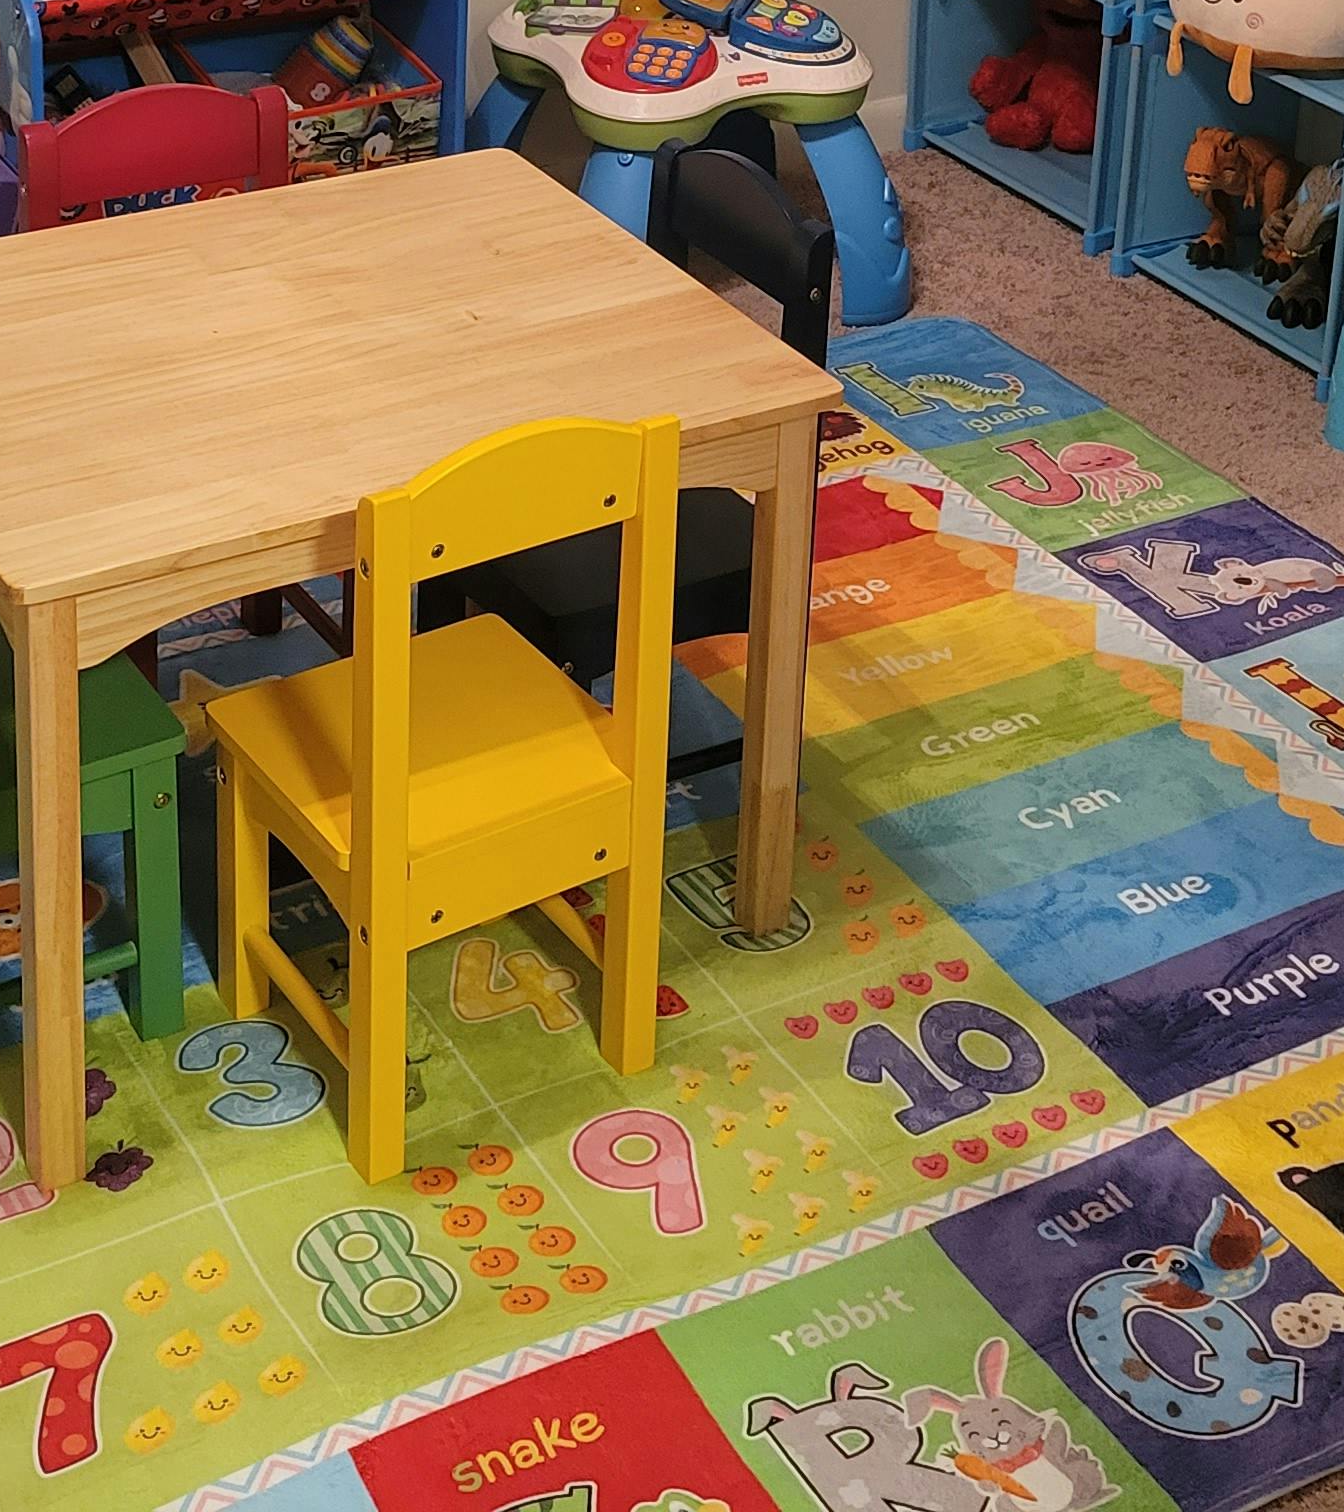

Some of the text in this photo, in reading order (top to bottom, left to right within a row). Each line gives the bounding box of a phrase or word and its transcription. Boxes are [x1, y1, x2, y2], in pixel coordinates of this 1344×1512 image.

[961, 405, 1050, 433] iguana
[987, 439, 1083, 508] J
[1078, 493, 1194, 537] jellyfish
[1077, 538, 1220, 620] K
[1244, 602, 1331, 636] koala
[839, 646, 952, 686] Yellow
[920, 707, 1042, 759] Green
[1015, 785, 1122, 833] Cyan
[1116, 872, 1212, 919] Blue
[451, 937, 584, 1035] 4
[1204, 945, 1343, 1017] Purple
[175, 1018, 327, 1130] 3
[845, 999, 1048, 1138] 10
[570, 1107, 705, 1238] 9
[1036, 1182, 1129, 1245] quail
[296, 1207, 461, 1338] 8
[769, 1284, 914, 1359] rabbit
[1067, 1267, 1305, 1438] Q
[449, 1404, 607, 1494] snake
